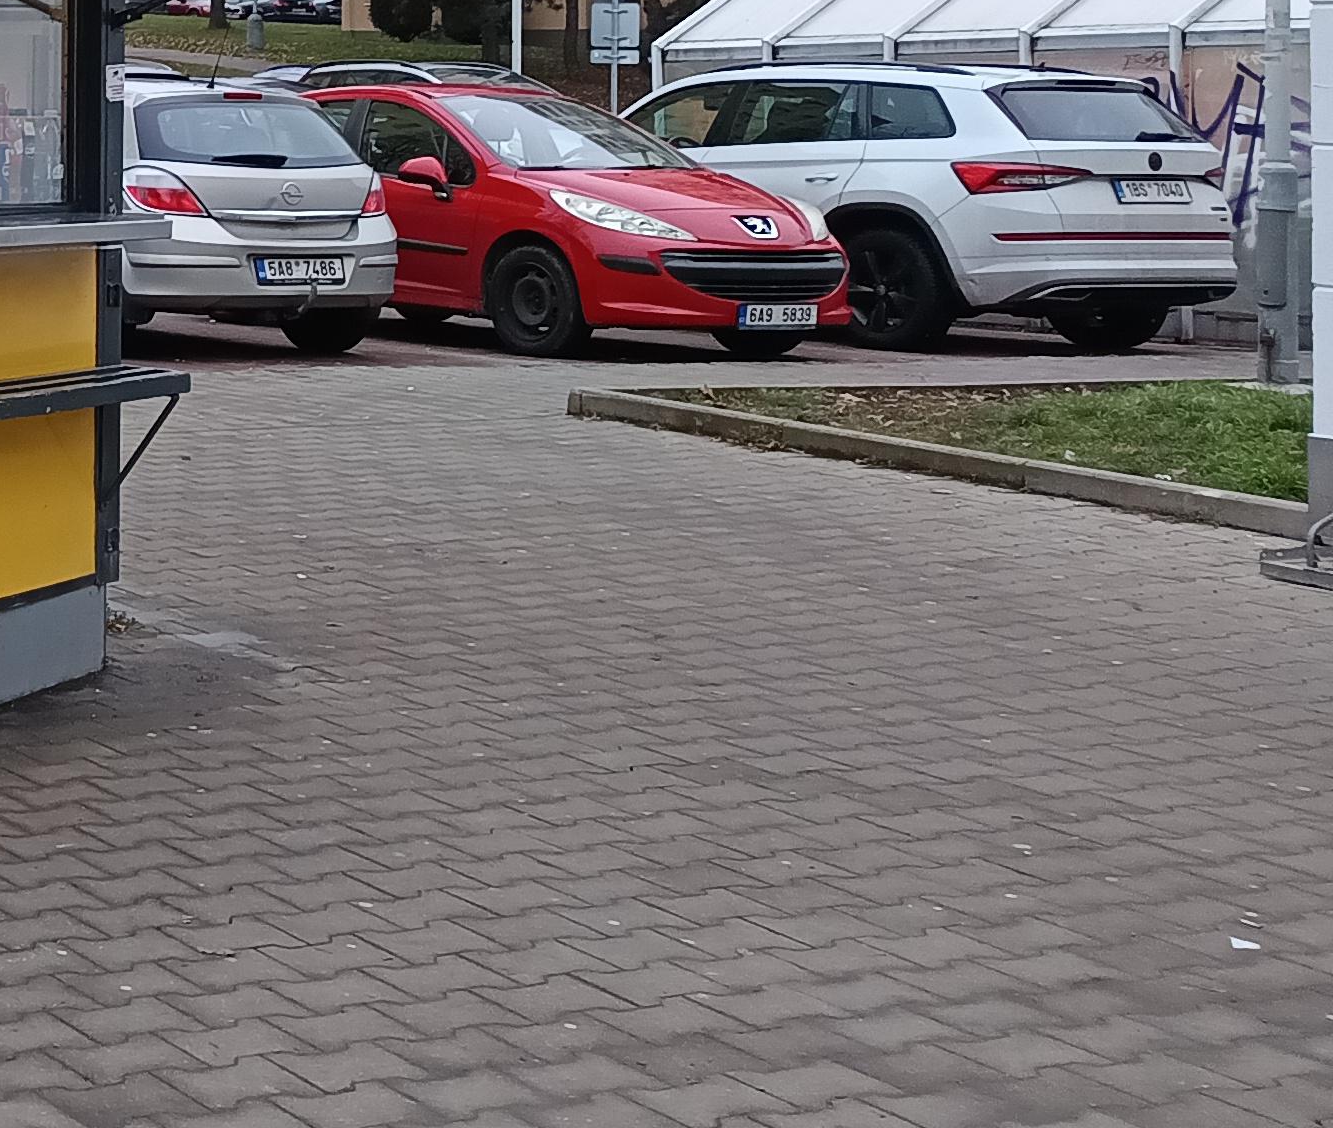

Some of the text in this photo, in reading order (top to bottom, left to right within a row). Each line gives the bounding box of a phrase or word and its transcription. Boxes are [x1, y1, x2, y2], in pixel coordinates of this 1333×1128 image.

[1125, 183, 1184, 197] 1BS 7040
[267, 260, 337, 276] 5A8 7486
[749, 307, 812, 322] 6A9 5839
